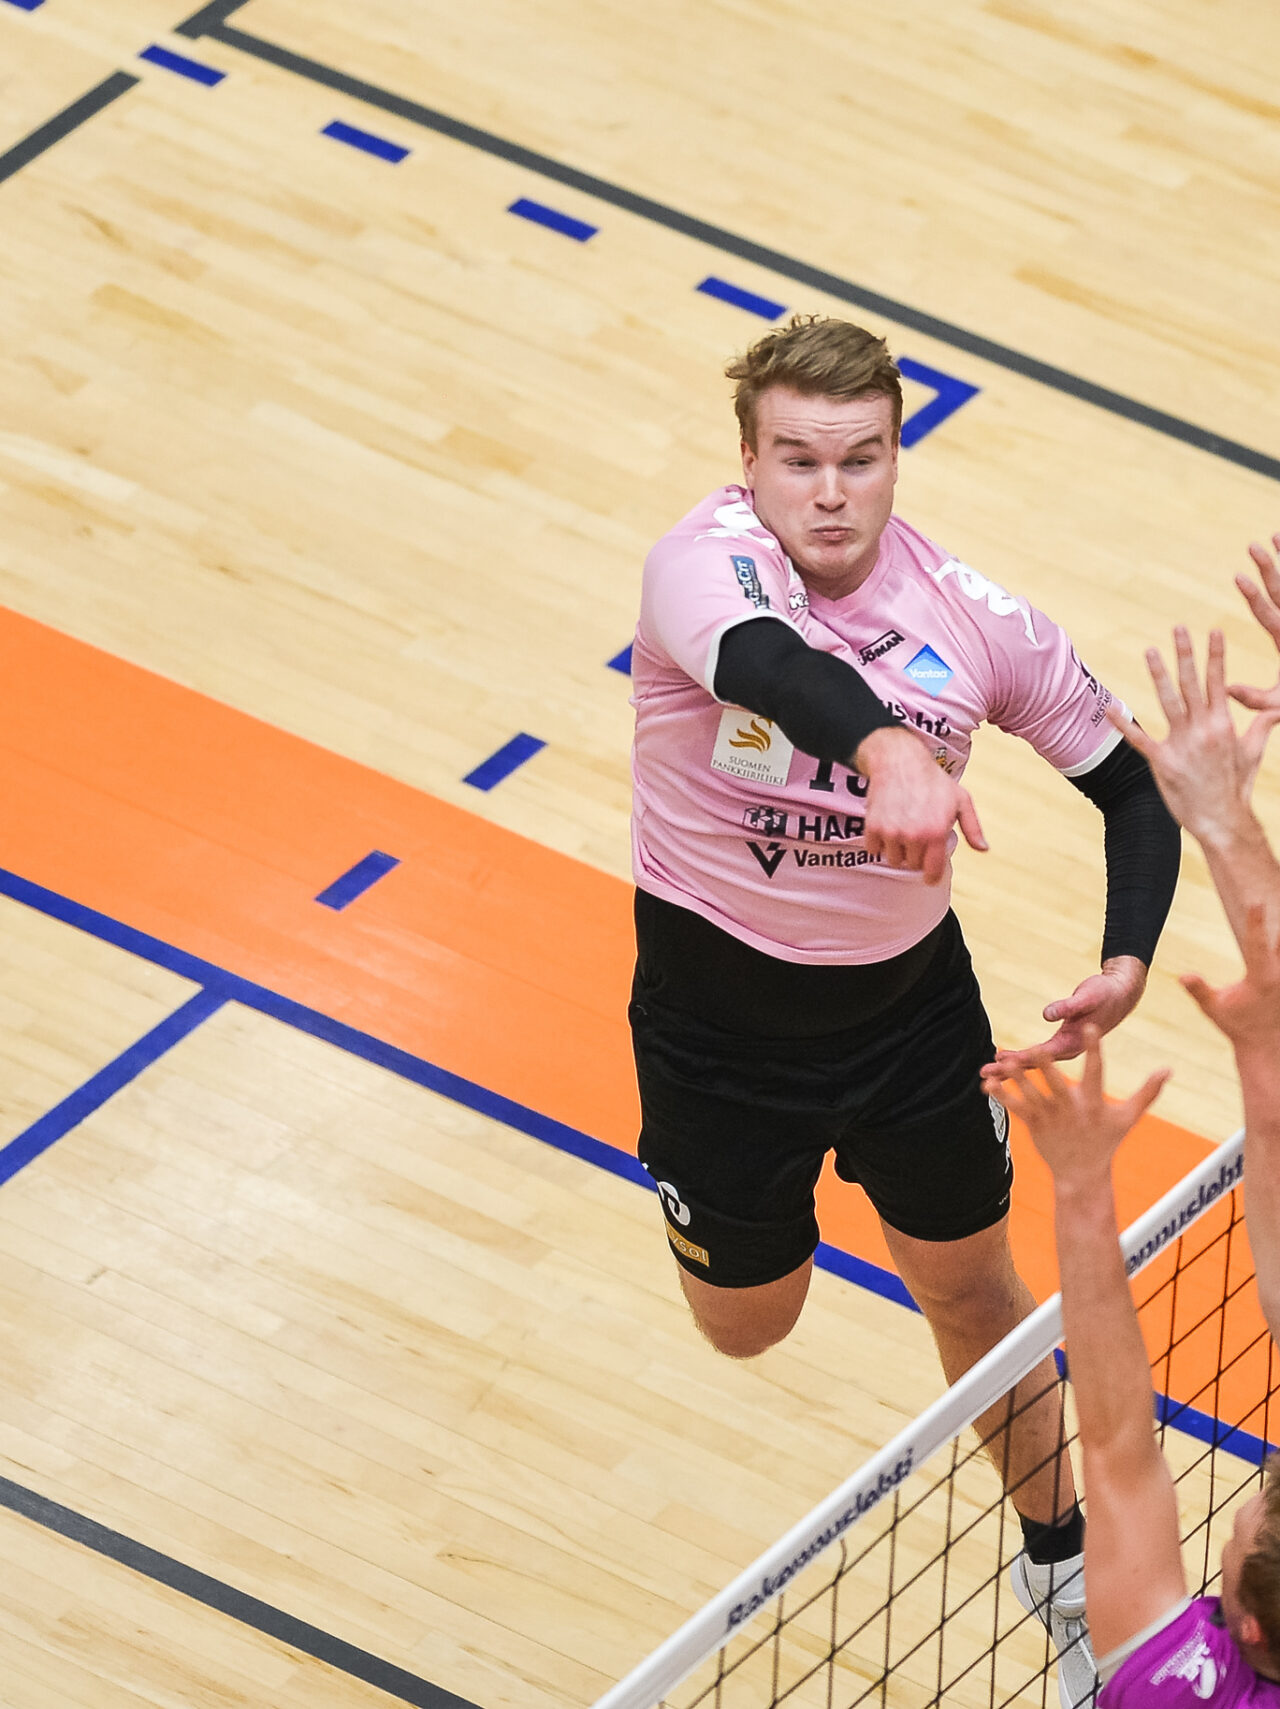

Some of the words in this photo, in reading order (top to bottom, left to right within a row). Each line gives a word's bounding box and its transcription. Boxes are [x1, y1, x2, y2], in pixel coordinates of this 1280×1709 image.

[909, 668, 948, 679] Vantaa
[712, 758, 786, 785] PANKKIIRILIIKE
[729, 755, 771, 772] SUOMEN
